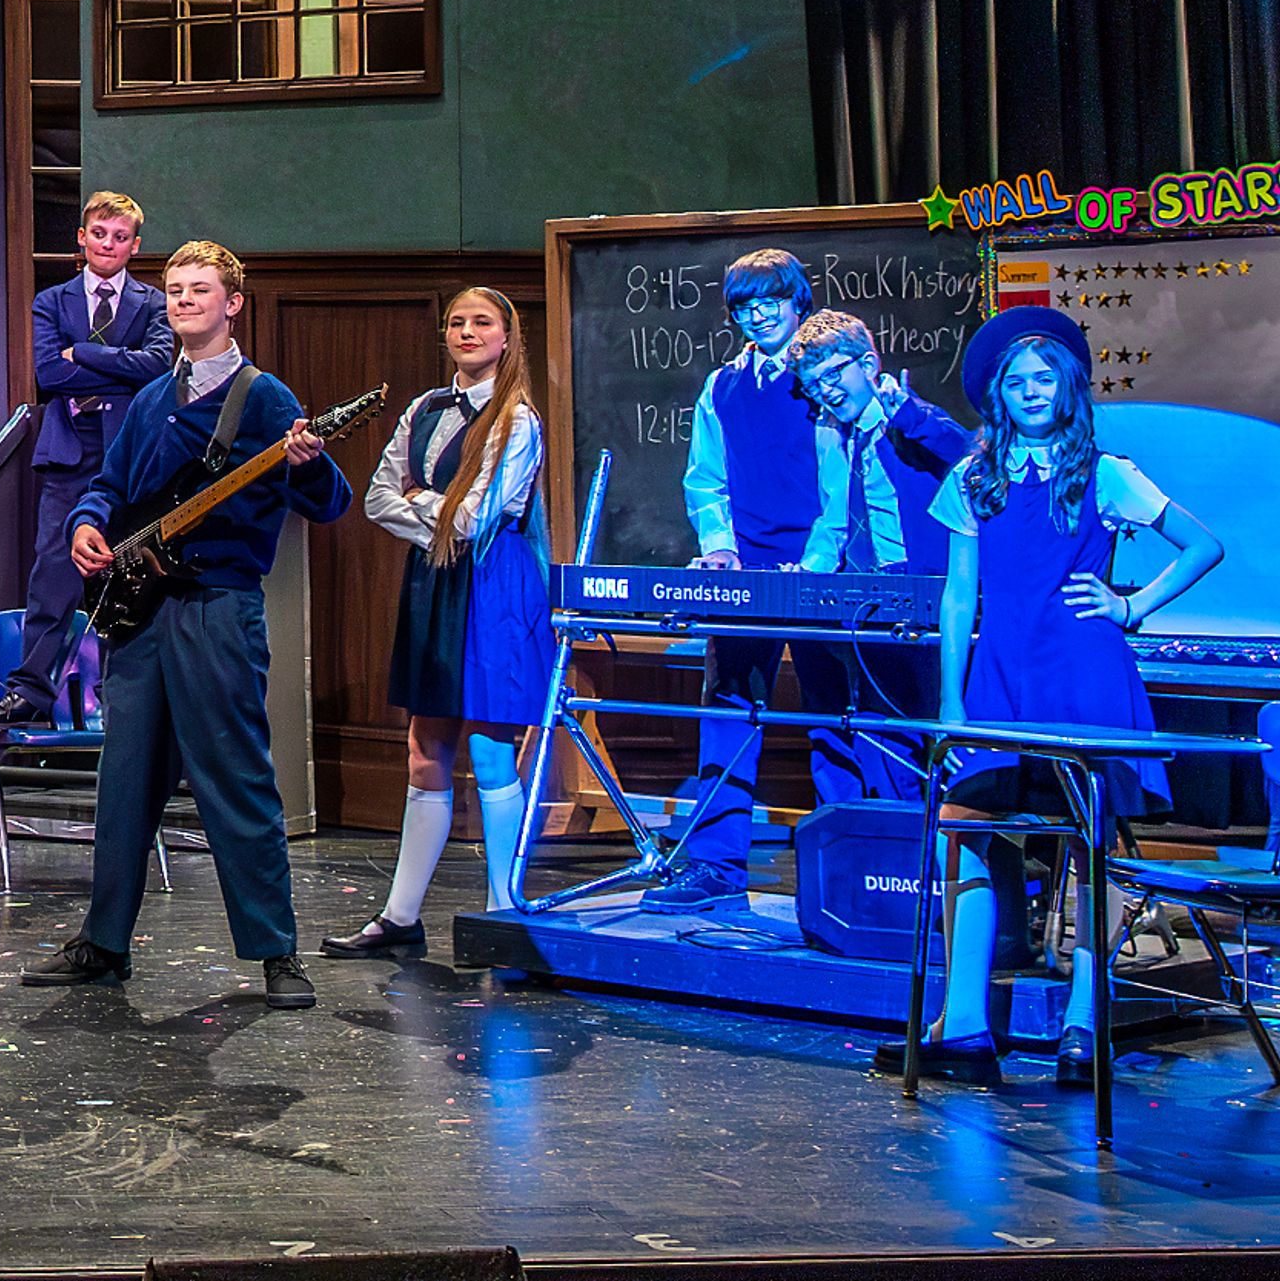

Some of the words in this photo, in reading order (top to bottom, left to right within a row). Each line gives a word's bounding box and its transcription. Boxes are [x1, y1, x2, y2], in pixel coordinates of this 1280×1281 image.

[960, 170, 1071, 230] WALL
[1076, 188, 1136, 232] OF
[1151, 166, 1280, 223] STAR
[824, 254, 893, 306] Rock
[901, 256, 978, 316] history
[876, 314, 965, 383] theory
[583, 577, 628, 599] KORG
[653, 582, 751, 606] Grandstage
